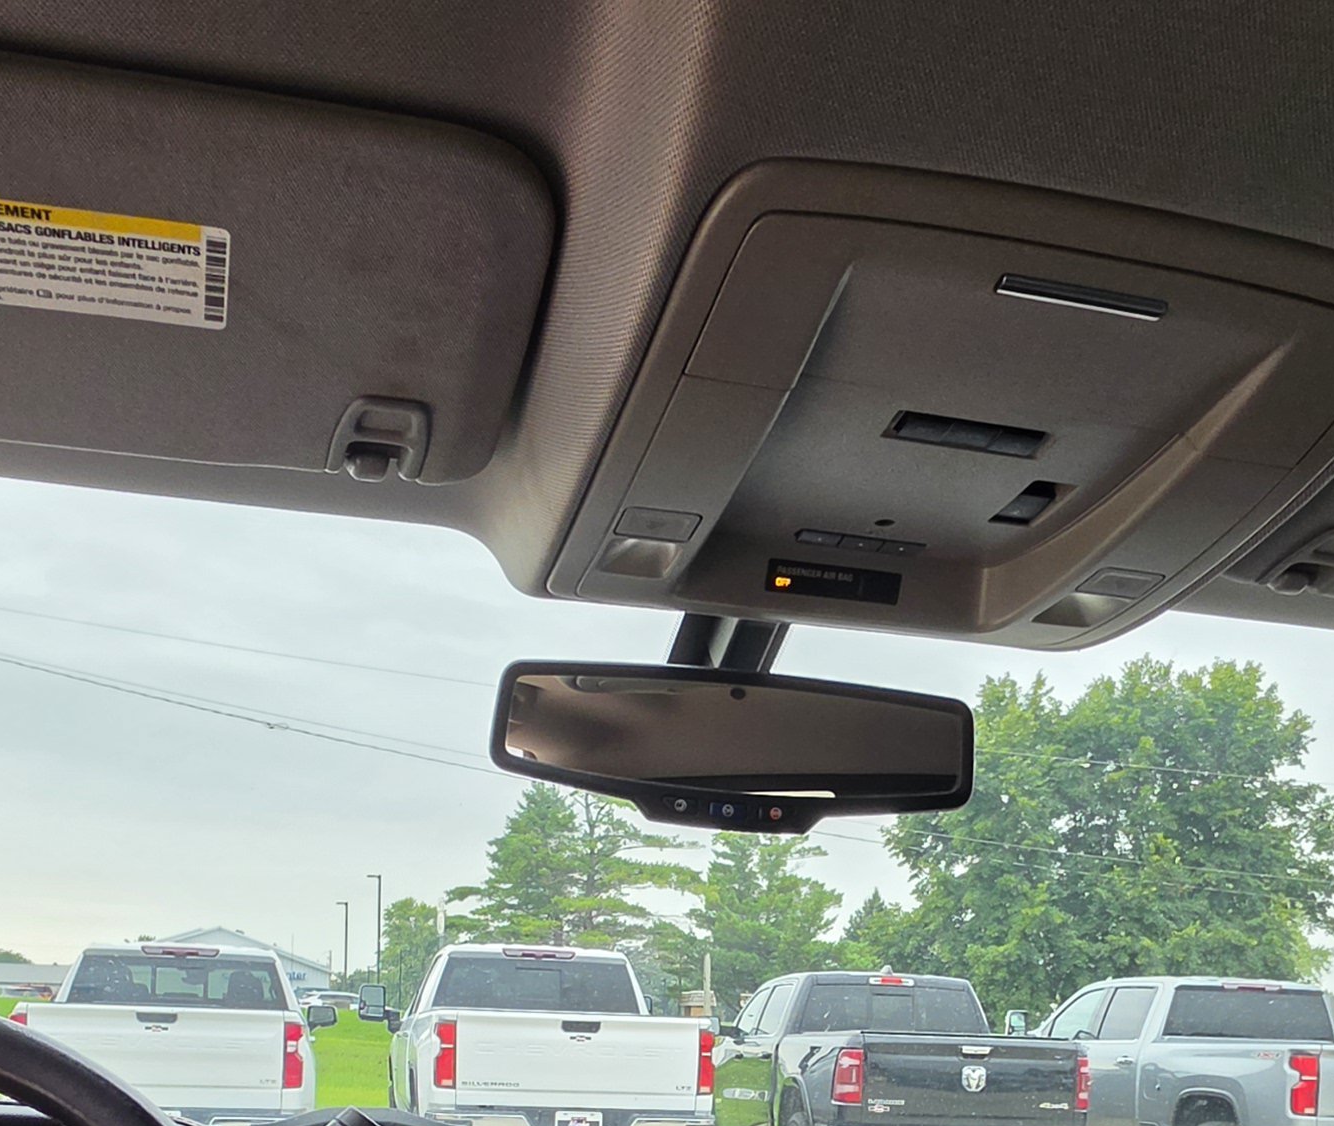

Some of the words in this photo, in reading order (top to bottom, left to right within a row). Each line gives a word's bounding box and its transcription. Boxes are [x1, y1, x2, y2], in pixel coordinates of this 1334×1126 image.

[34, 225, 114, 245] GONFLABLES
[117, 235, 201, 256] INTELLIGENTS
[776, 565, 822, 577] PASSENGER
[823, 571, 836, 580] AIR
[837, 572, 854, 582] BAG
